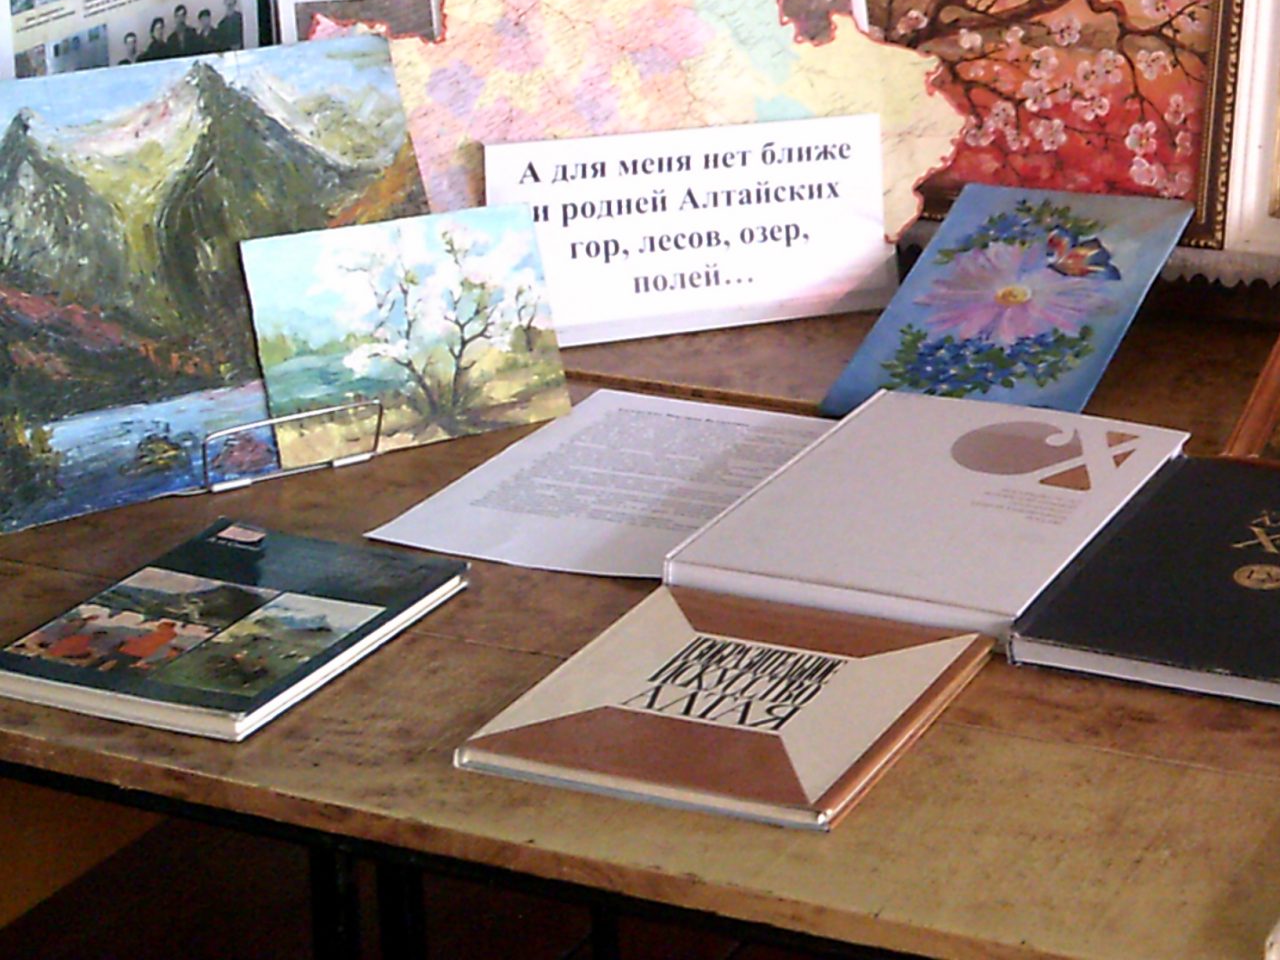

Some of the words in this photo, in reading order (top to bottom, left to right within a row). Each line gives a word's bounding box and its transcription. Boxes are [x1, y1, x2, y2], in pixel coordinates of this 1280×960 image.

[518, 160, 542, 185] А
[551, 159, 607, 184] для
[618, 152, 692, 177] меня
[703, 146, 753, 172] нет
[760, 139, 852, 167] ближе
[532, 202, 550, 223] и
[561, 187, 668, 227] родней
[678, 179, 841, 211] Алтайских
[570, 237, 630, 264] гор,
[638, 225, 731, 254] лесов,
[739, 218, 810, 245] озер,
[633, 263, 754, 295] полей...
[648, 660, 823, 707] ИСКУССТВО
[619, 685, 802, 731] АЛТАЯ
